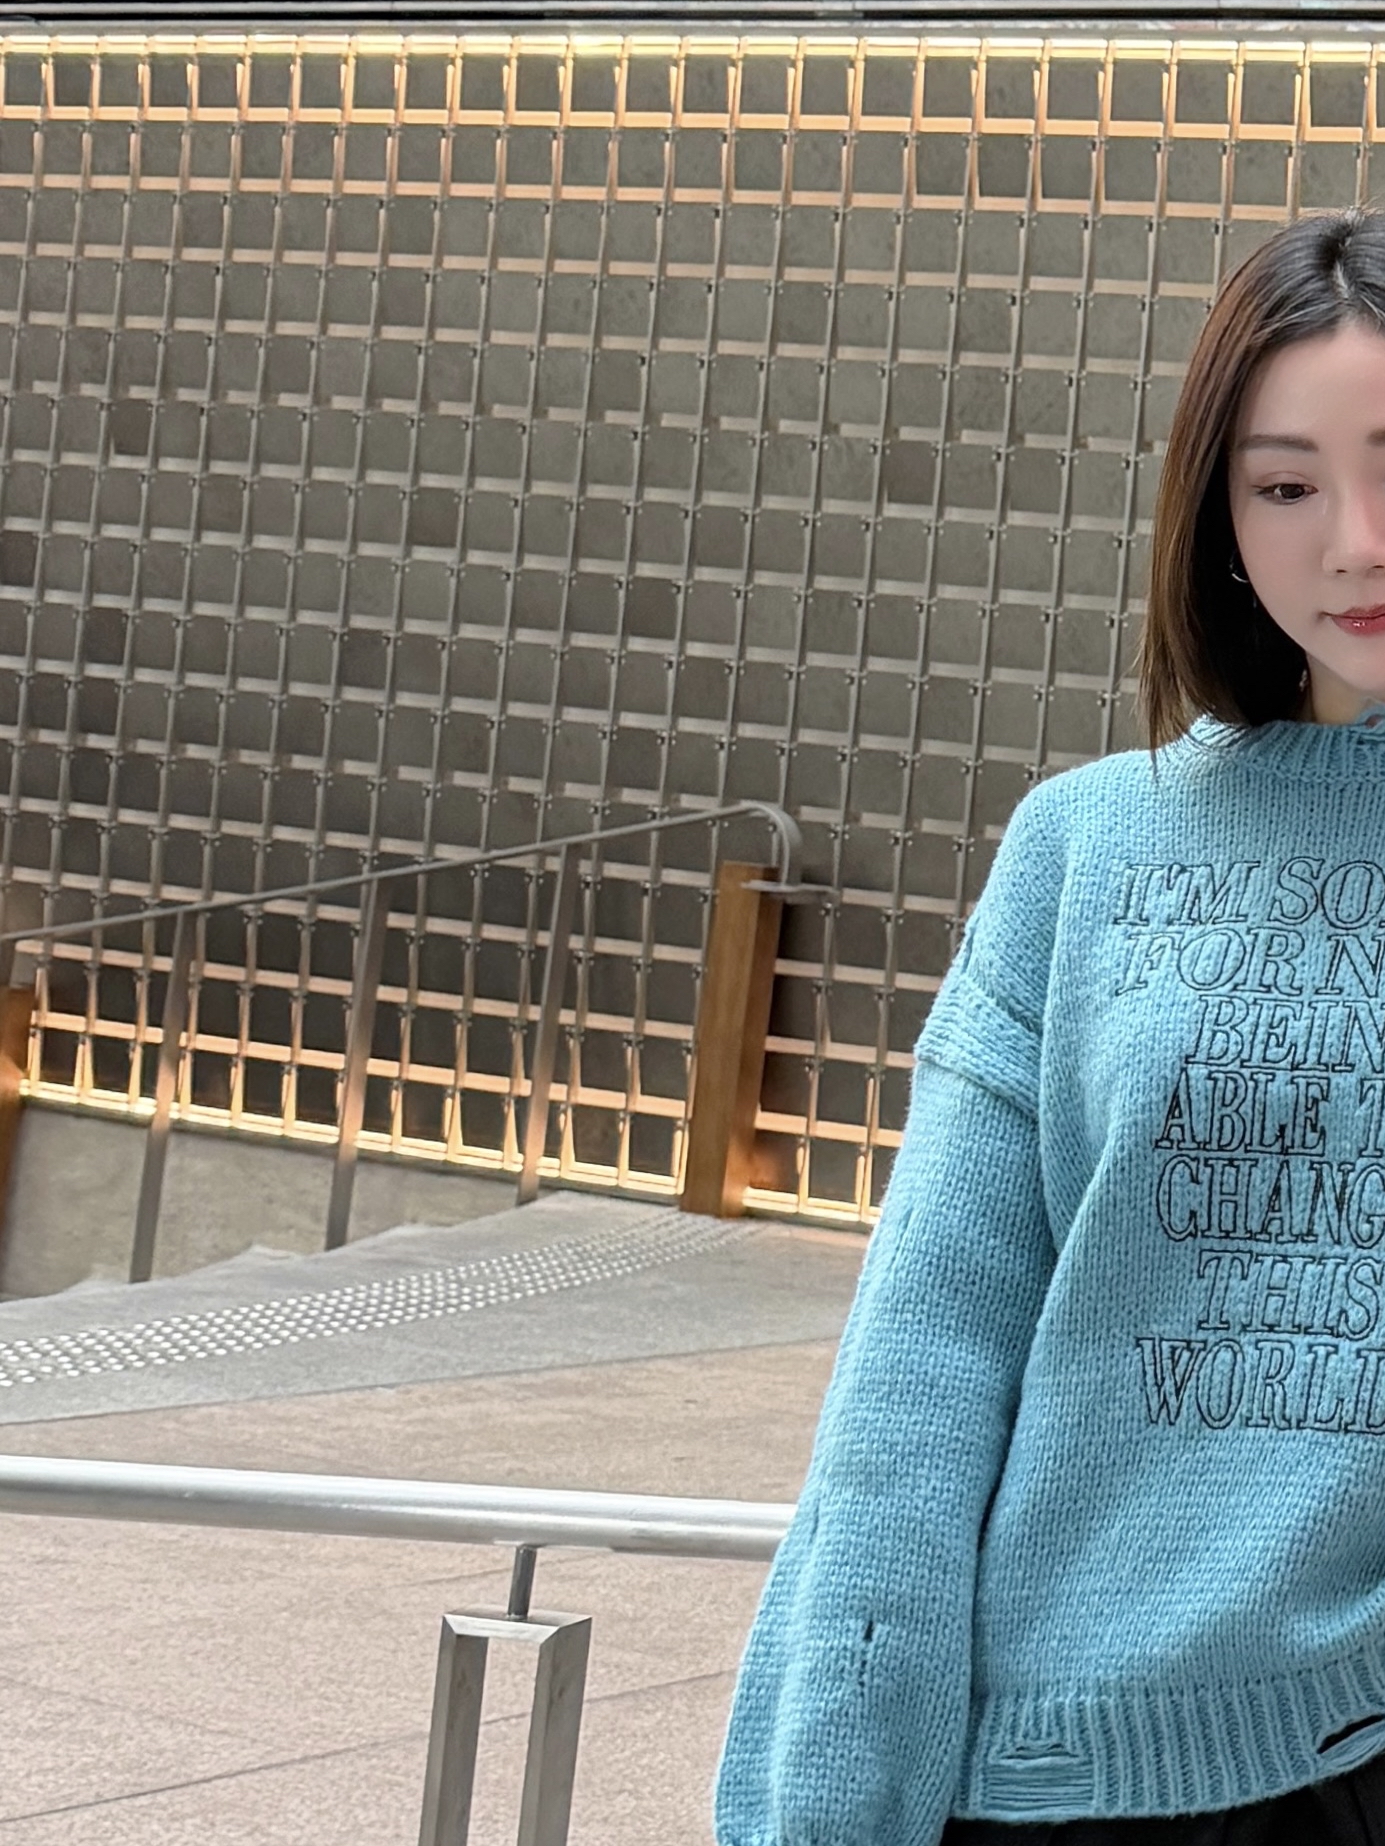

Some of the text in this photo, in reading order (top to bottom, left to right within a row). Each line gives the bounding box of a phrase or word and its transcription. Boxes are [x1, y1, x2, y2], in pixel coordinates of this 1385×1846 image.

[1112, 861, 1260, 926] I'M
[1115, 928, 1310, 996] FOR
[1154, 1069, 1330, 1156] ABLE
[1198, 1249, 1385, 1341] THIS
